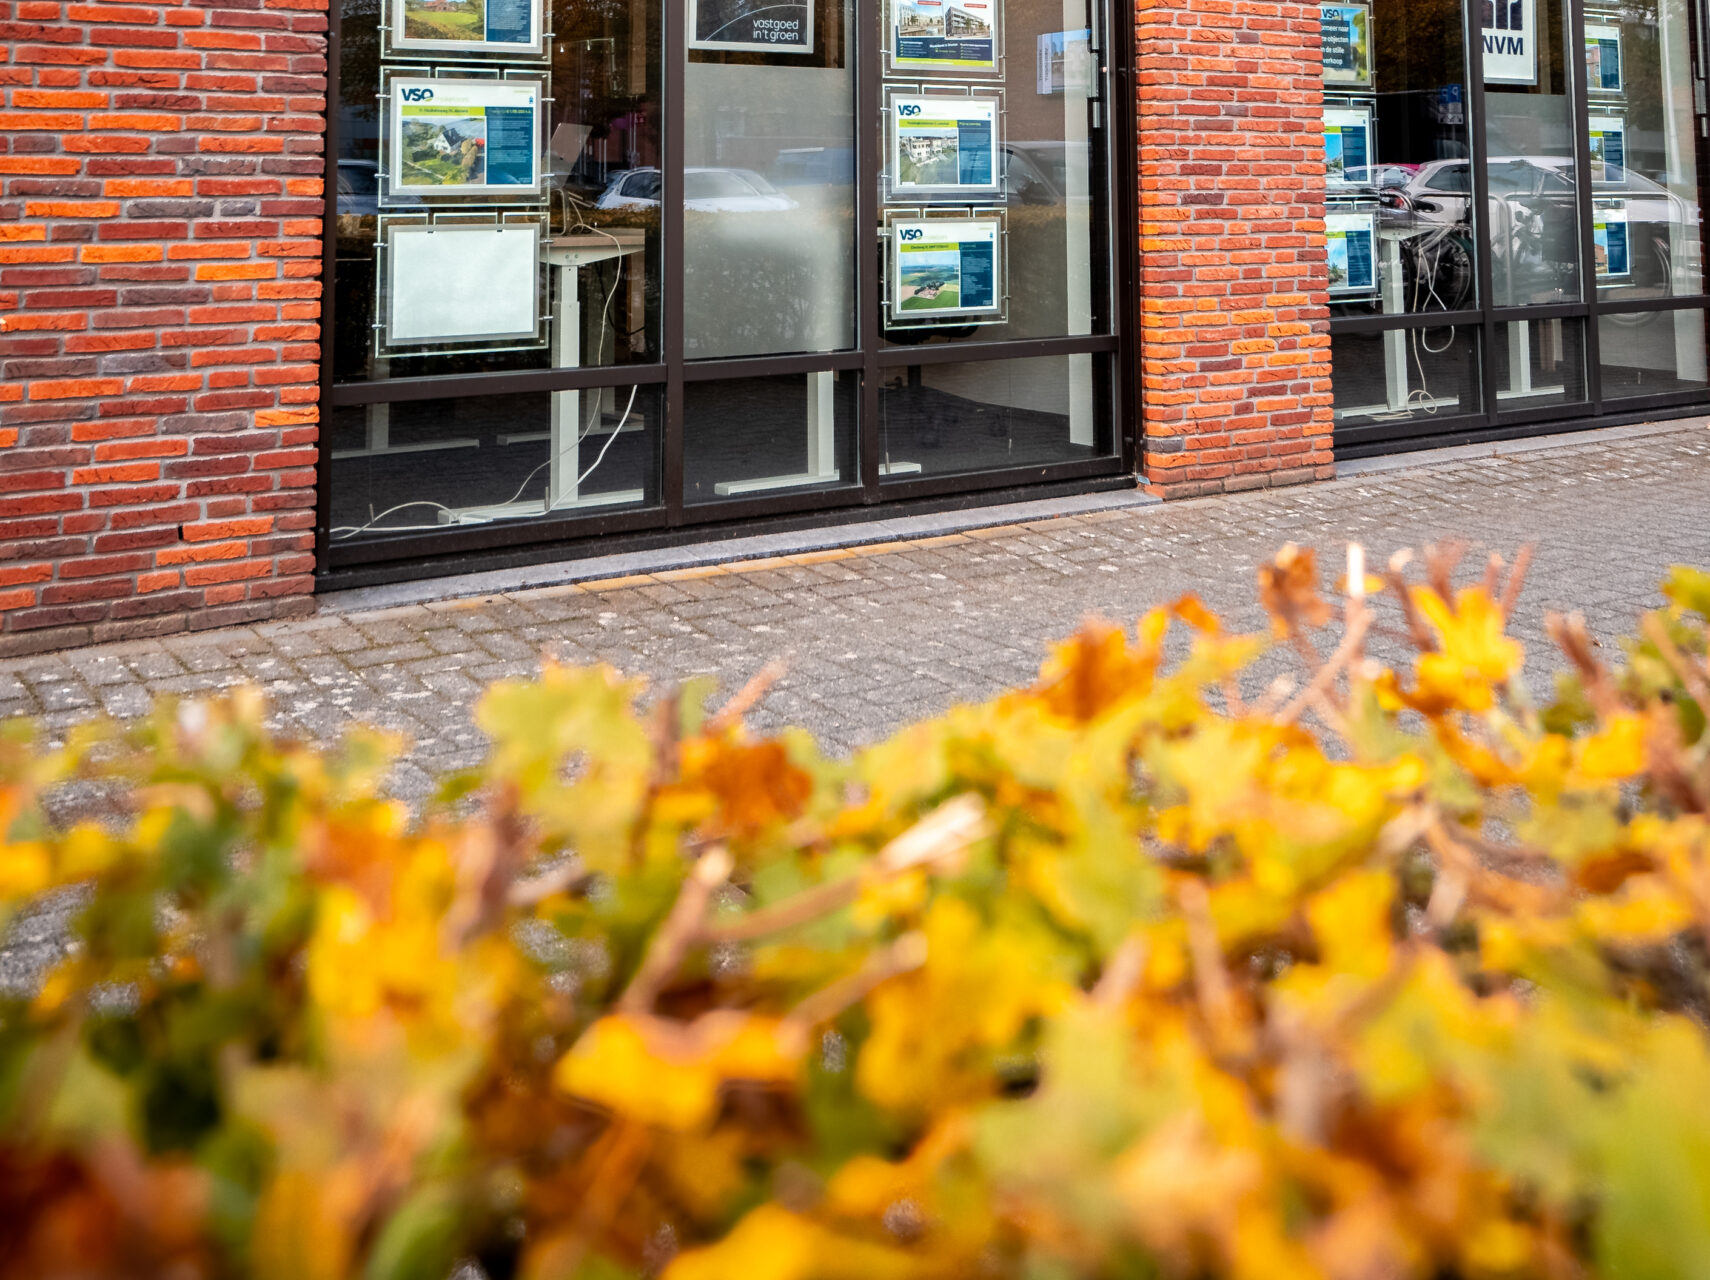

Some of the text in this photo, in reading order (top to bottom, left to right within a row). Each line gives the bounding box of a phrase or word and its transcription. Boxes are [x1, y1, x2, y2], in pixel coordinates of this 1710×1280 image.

[753, 18, 799, 32] vastgoed
[770, 30, 799, 42] groen
[1483, 35, 1524, 56] NVM
[401, 88, 434, 102] VSO
